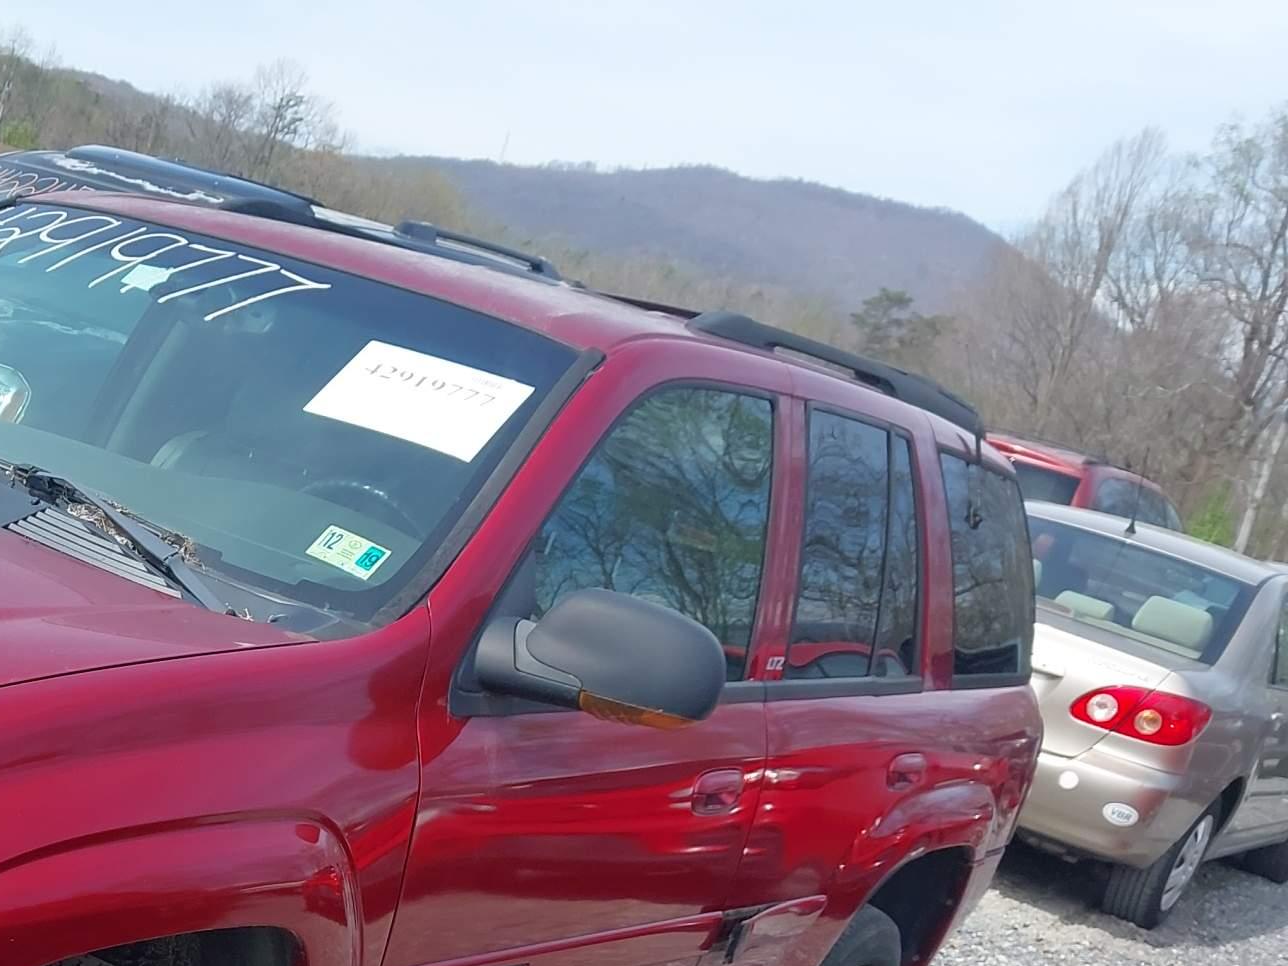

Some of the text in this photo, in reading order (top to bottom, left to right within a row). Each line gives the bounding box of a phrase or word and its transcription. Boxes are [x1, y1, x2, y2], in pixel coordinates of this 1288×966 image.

[365, 363, 497, 407] 42919777
[322, 532, 345, 551] 12
[360, 552, 381, 569] 19
